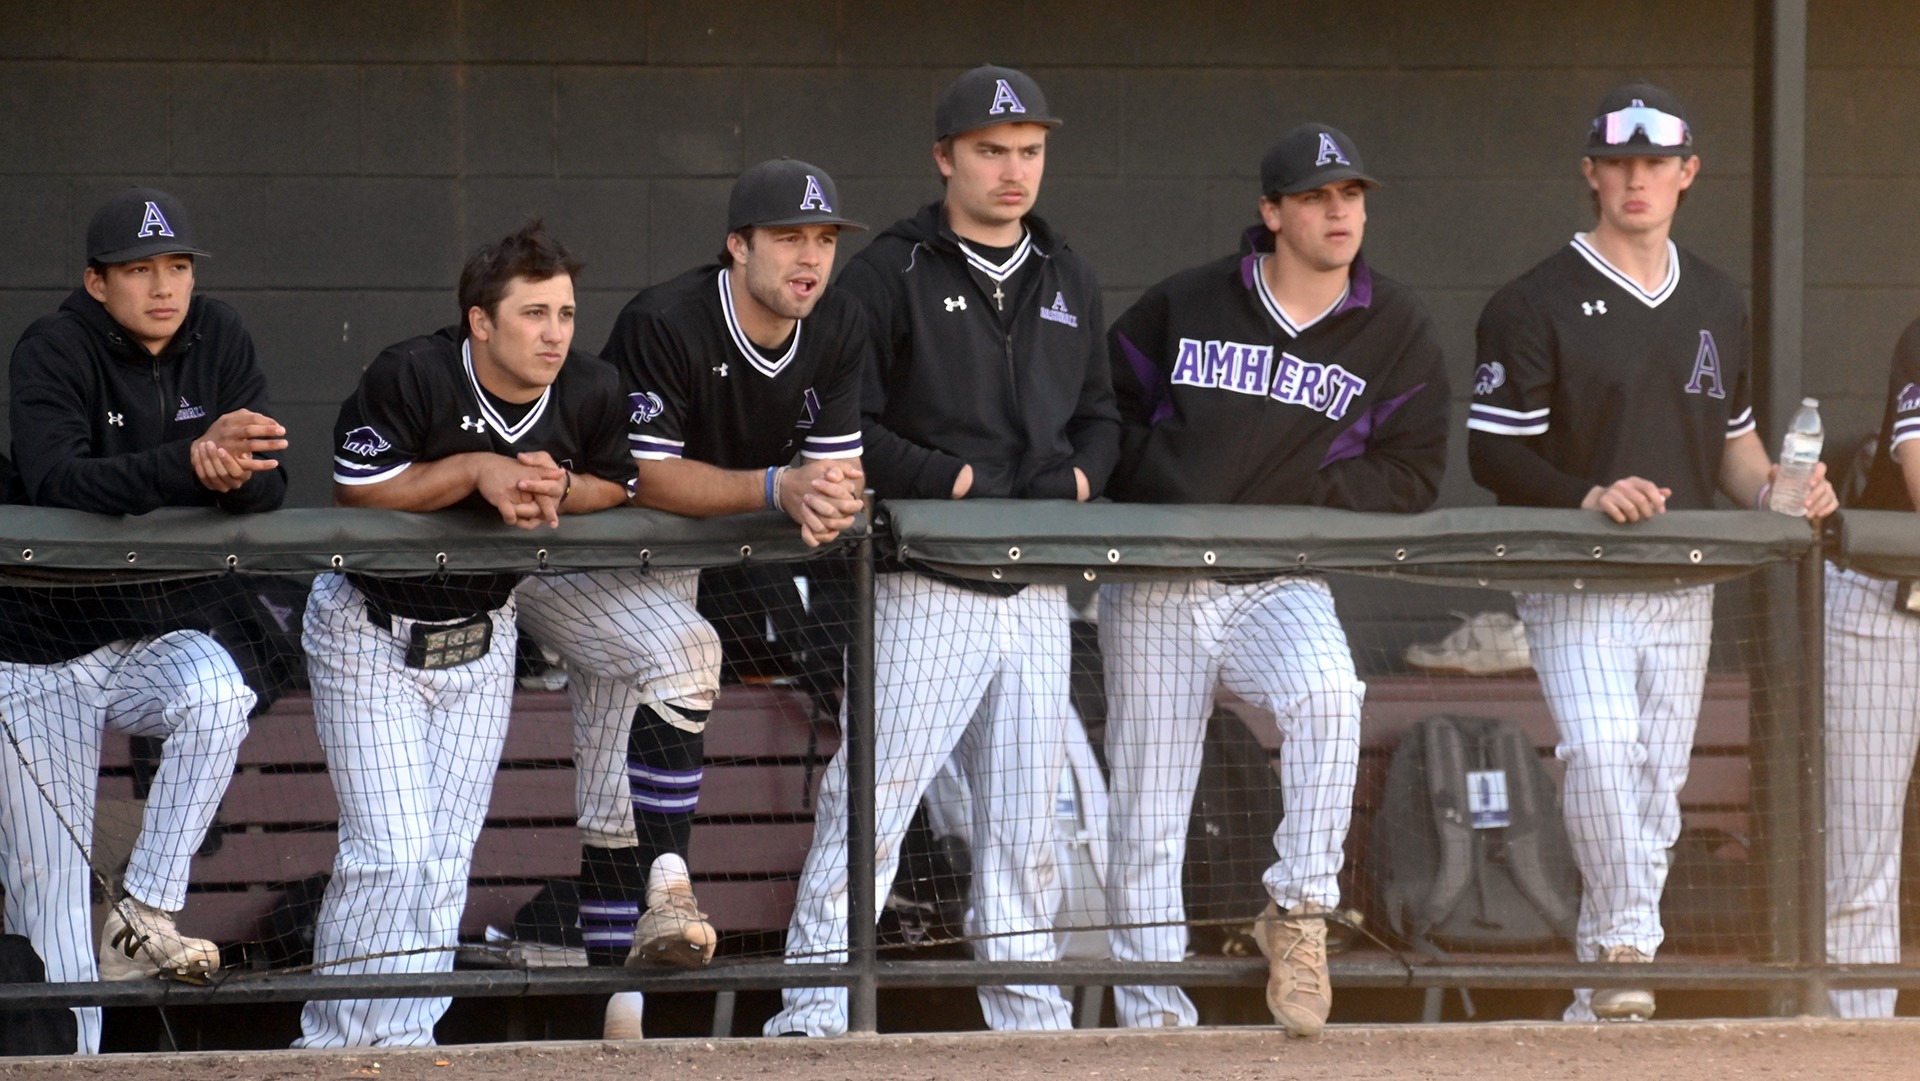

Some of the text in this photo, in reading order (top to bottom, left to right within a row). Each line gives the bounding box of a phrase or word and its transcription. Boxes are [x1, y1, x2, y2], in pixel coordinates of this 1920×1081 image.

[989, 79, 1026, 115] A
[1315, 132, 1351, 167] A
[800, 174, 832, 213] A
[137, 201, 175, 238] A
[1051, 291, 1068, 313] A
[1171, 338, 1367, 421] AMHERST
[1684, 329, 1726, 399] A
